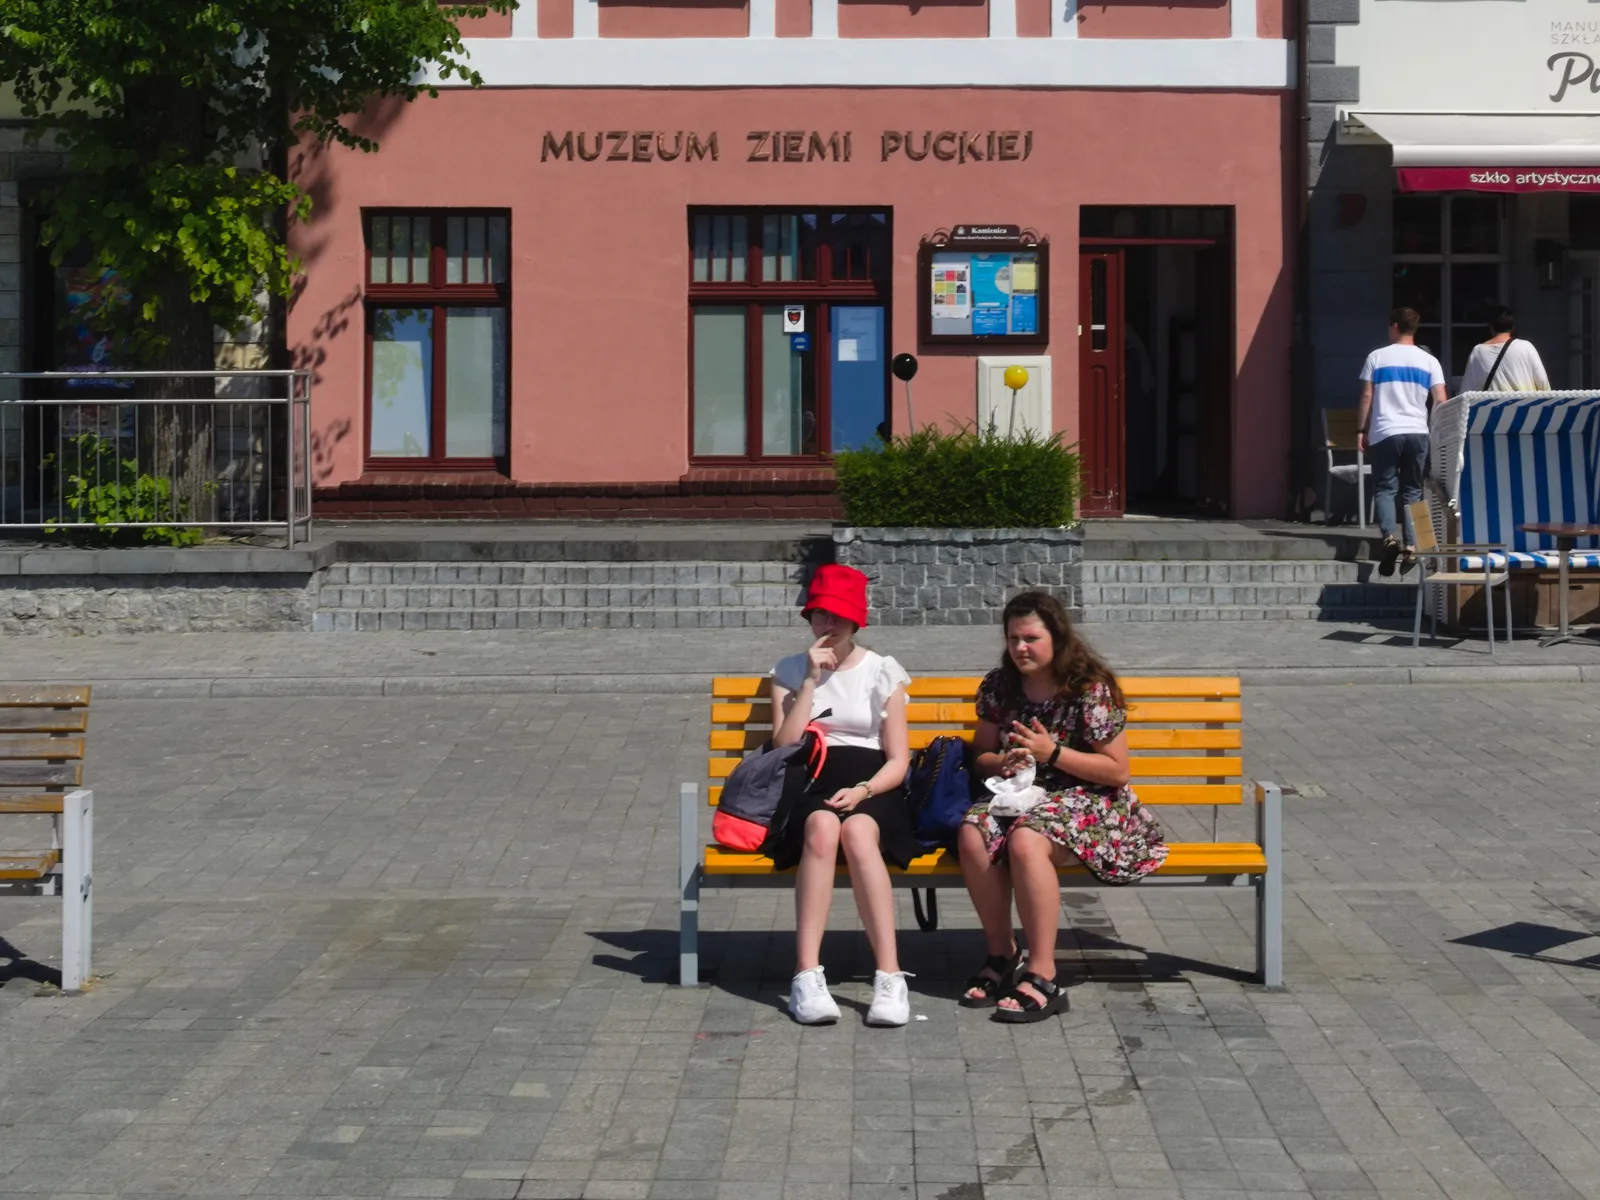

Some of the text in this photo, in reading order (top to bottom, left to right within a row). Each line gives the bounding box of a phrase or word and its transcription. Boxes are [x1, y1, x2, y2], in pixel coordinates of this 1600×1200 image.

[540, 130, 1034, 165] MUZEUM ZIEMI PUCKIEJ
[1469, 171, 1511, 184] szkło
